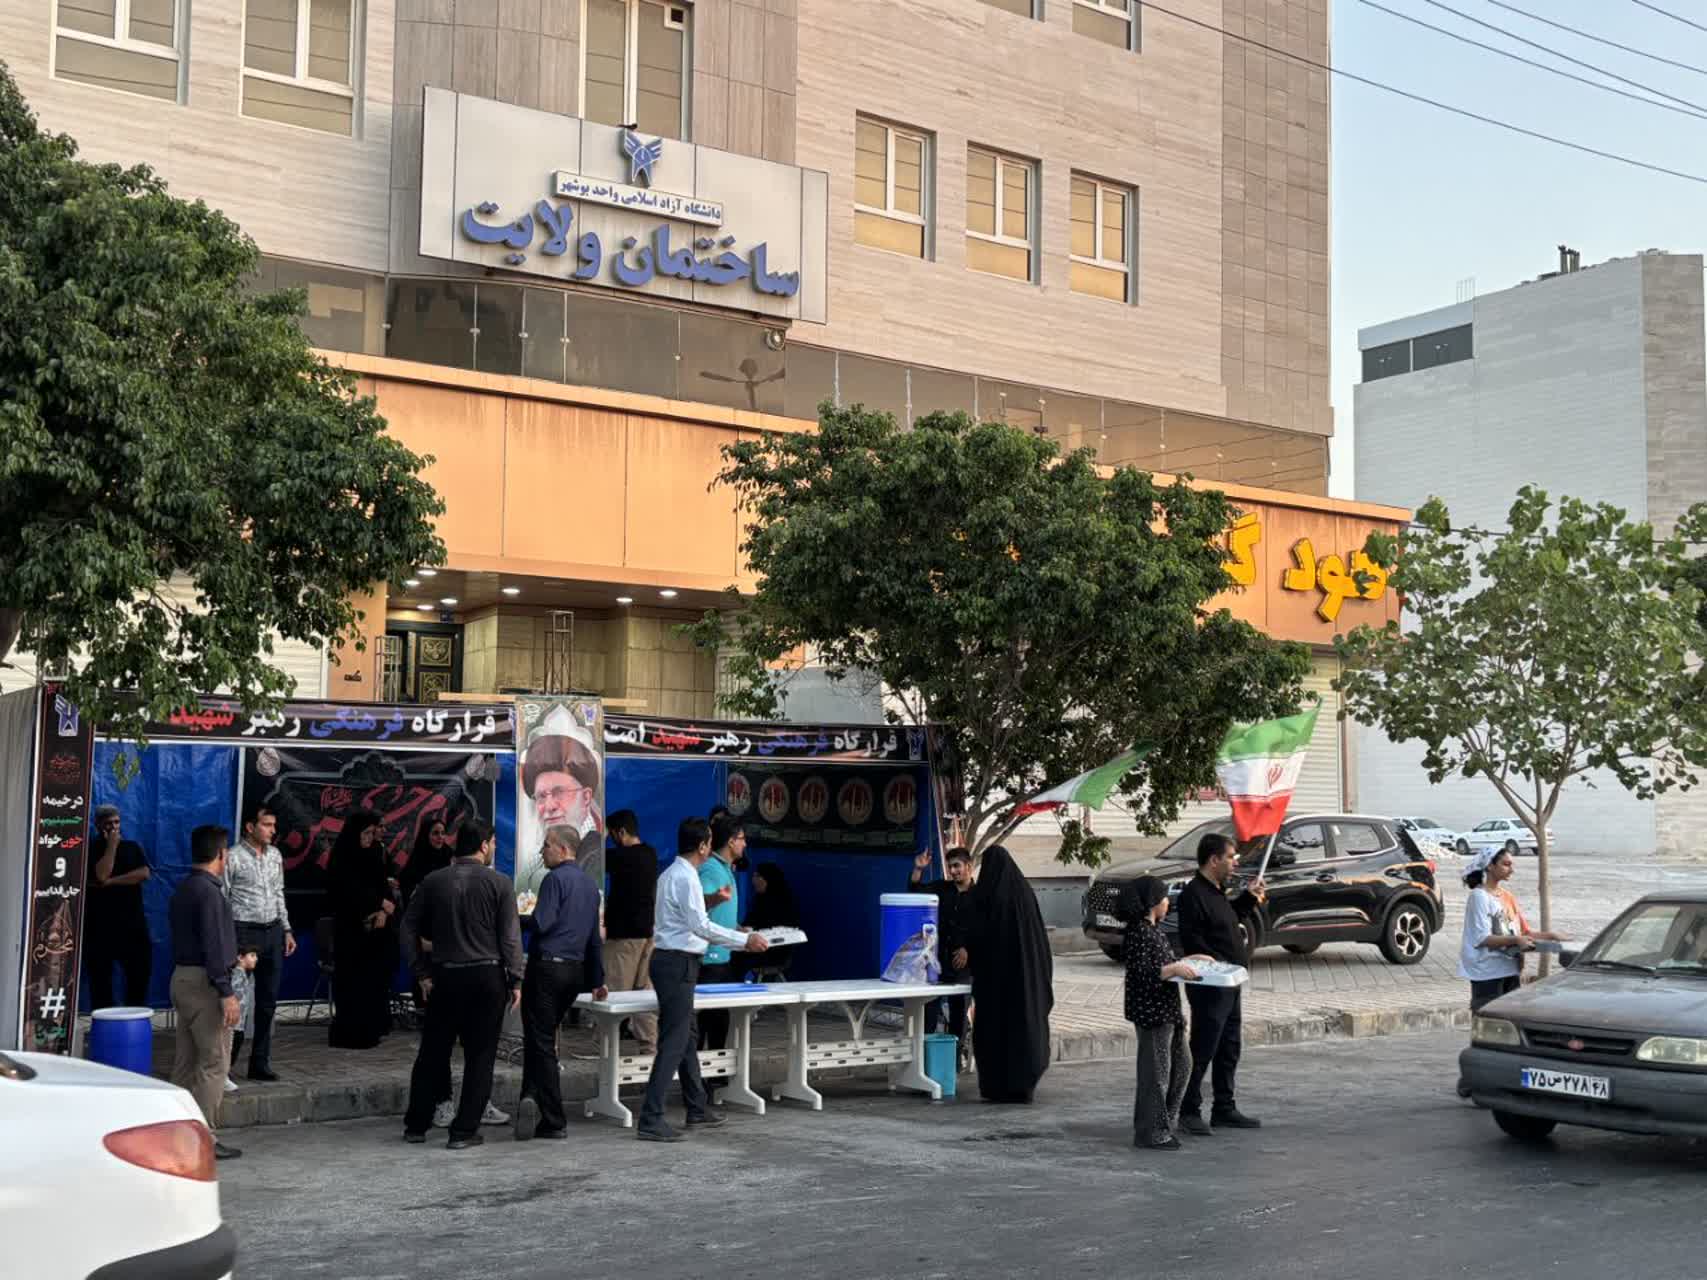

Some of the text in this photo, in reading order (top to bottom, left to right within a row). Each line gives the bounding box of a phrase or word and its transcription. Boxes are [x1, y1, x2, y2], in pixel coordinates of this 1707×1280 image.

[560, 178, 721, 220] دانشگاه آزاد اسلامی واحد بوشهر
[463, 199, 799, 297] ساختمان ولایت
[168, 703, 234, 733] شهید
[241, 709, 301, 738] رهبر
[309, 707, 404, 741] فرهنگی
[412, 708, 496, 743] قرارگاه
[652, 725, 700, 752] شهید
[704, 730, 752, 755] رهبر
[758, 731, 828, 758] فرهنگی
[833, 728, 898, 758] قرارگاه
[53, 856, 67, 879] و
